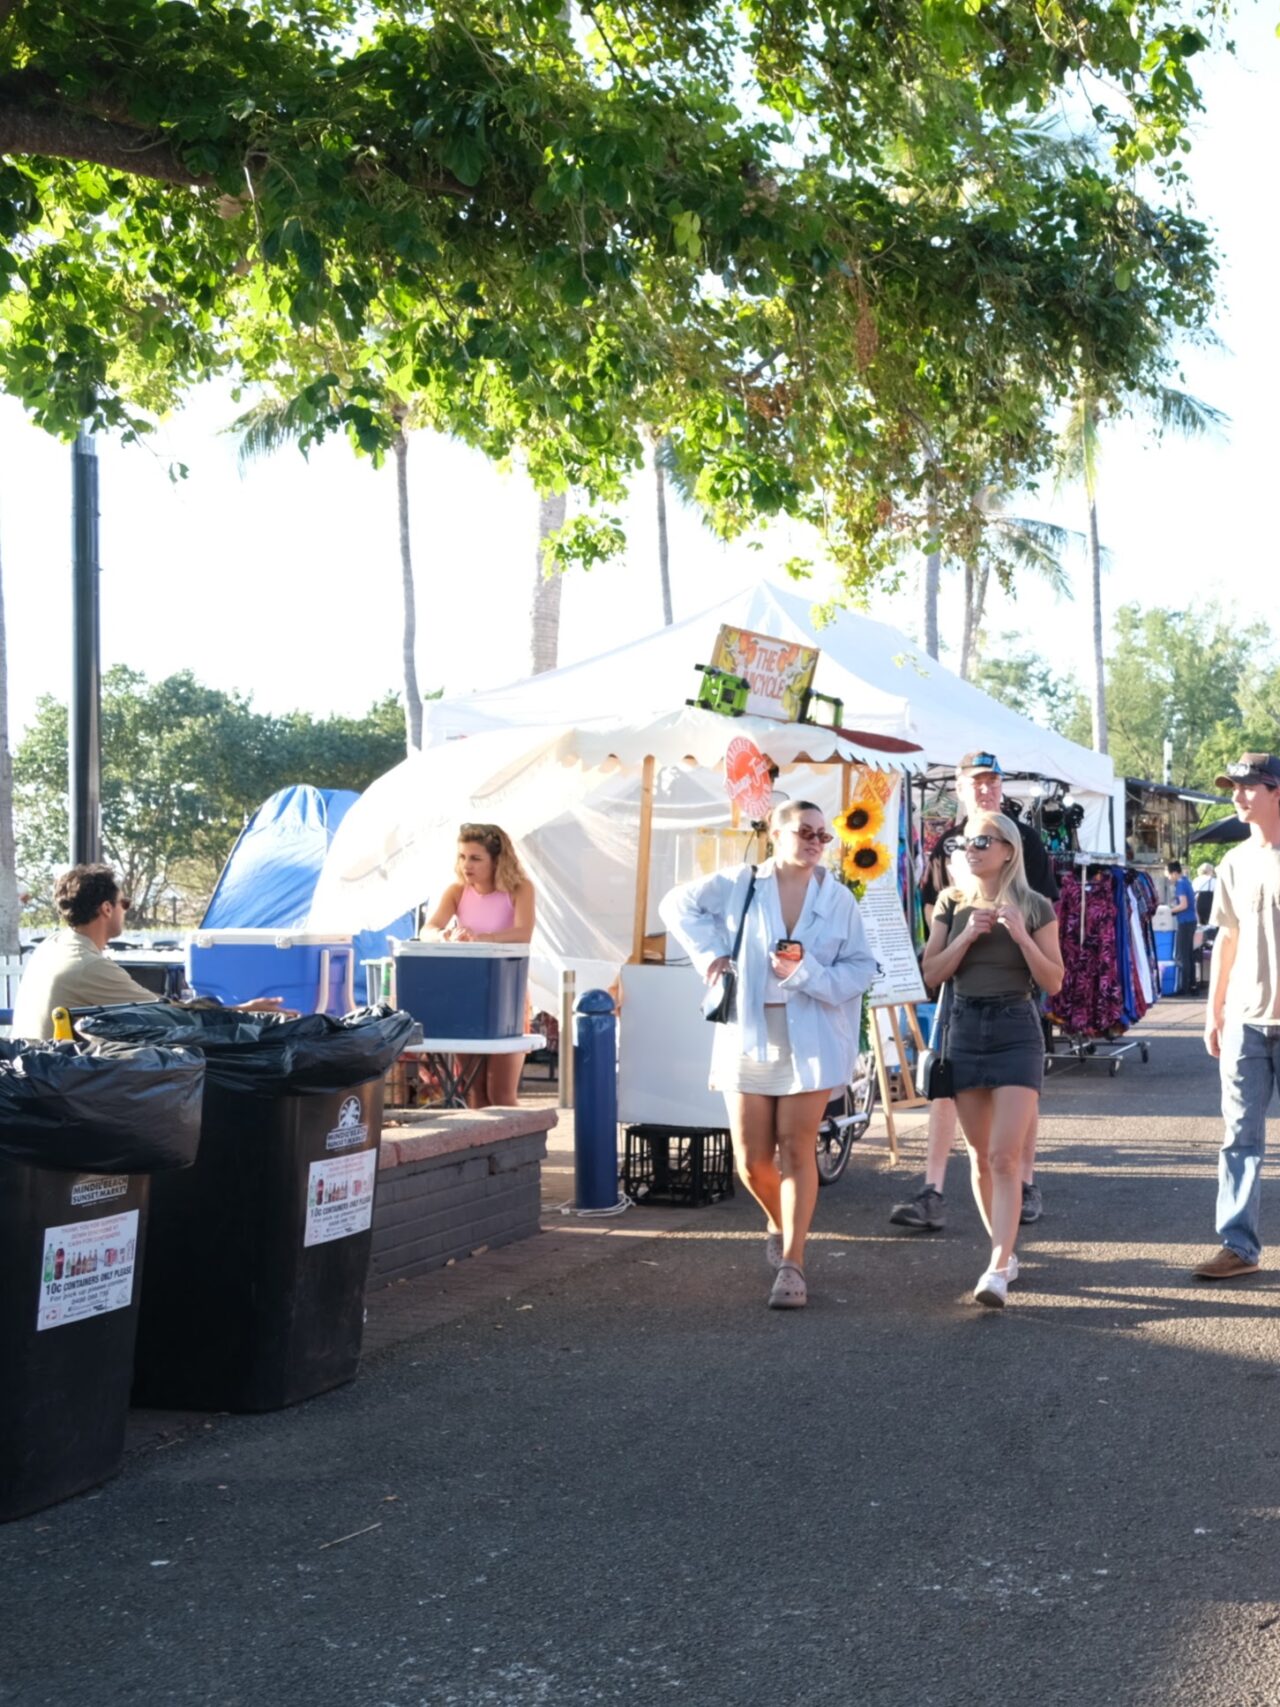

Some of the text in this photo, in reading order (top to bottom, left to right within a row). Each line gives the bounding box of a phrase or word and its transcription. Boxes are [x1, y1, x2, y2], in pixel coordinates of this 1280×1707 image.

[757, 647, 779, 673] THE
[46, 1265, 133, 1295] 10c CONTAINERS ONLY PLEASE
